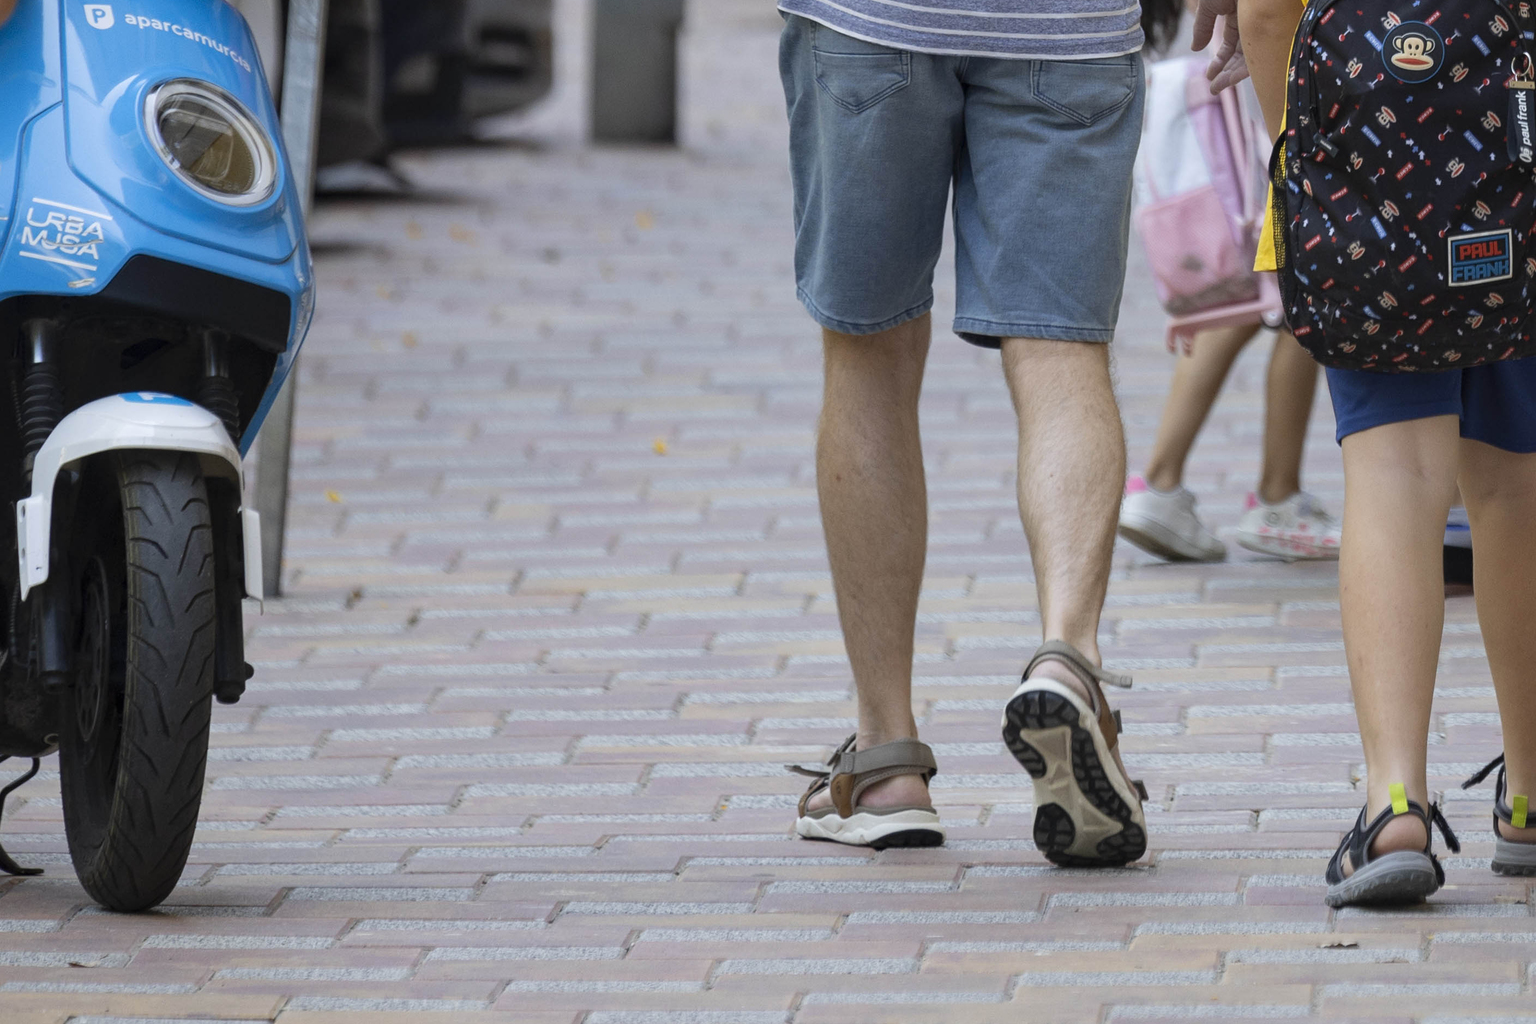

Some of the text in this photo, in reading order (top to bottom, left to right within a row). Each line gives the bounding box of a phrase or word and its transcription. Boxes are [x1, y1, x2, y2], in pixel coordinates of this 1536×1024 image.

[124, 13, 251, 73] aparcamurcia
[1514, 90, 1533, 147] paul frank
[26, 207, 104, 242] URBA
[21, 226, 99, 260] MUSA
[1459, 240, 1503, 261] PAUL
[1452, 259, 1510, 282] FRANK
